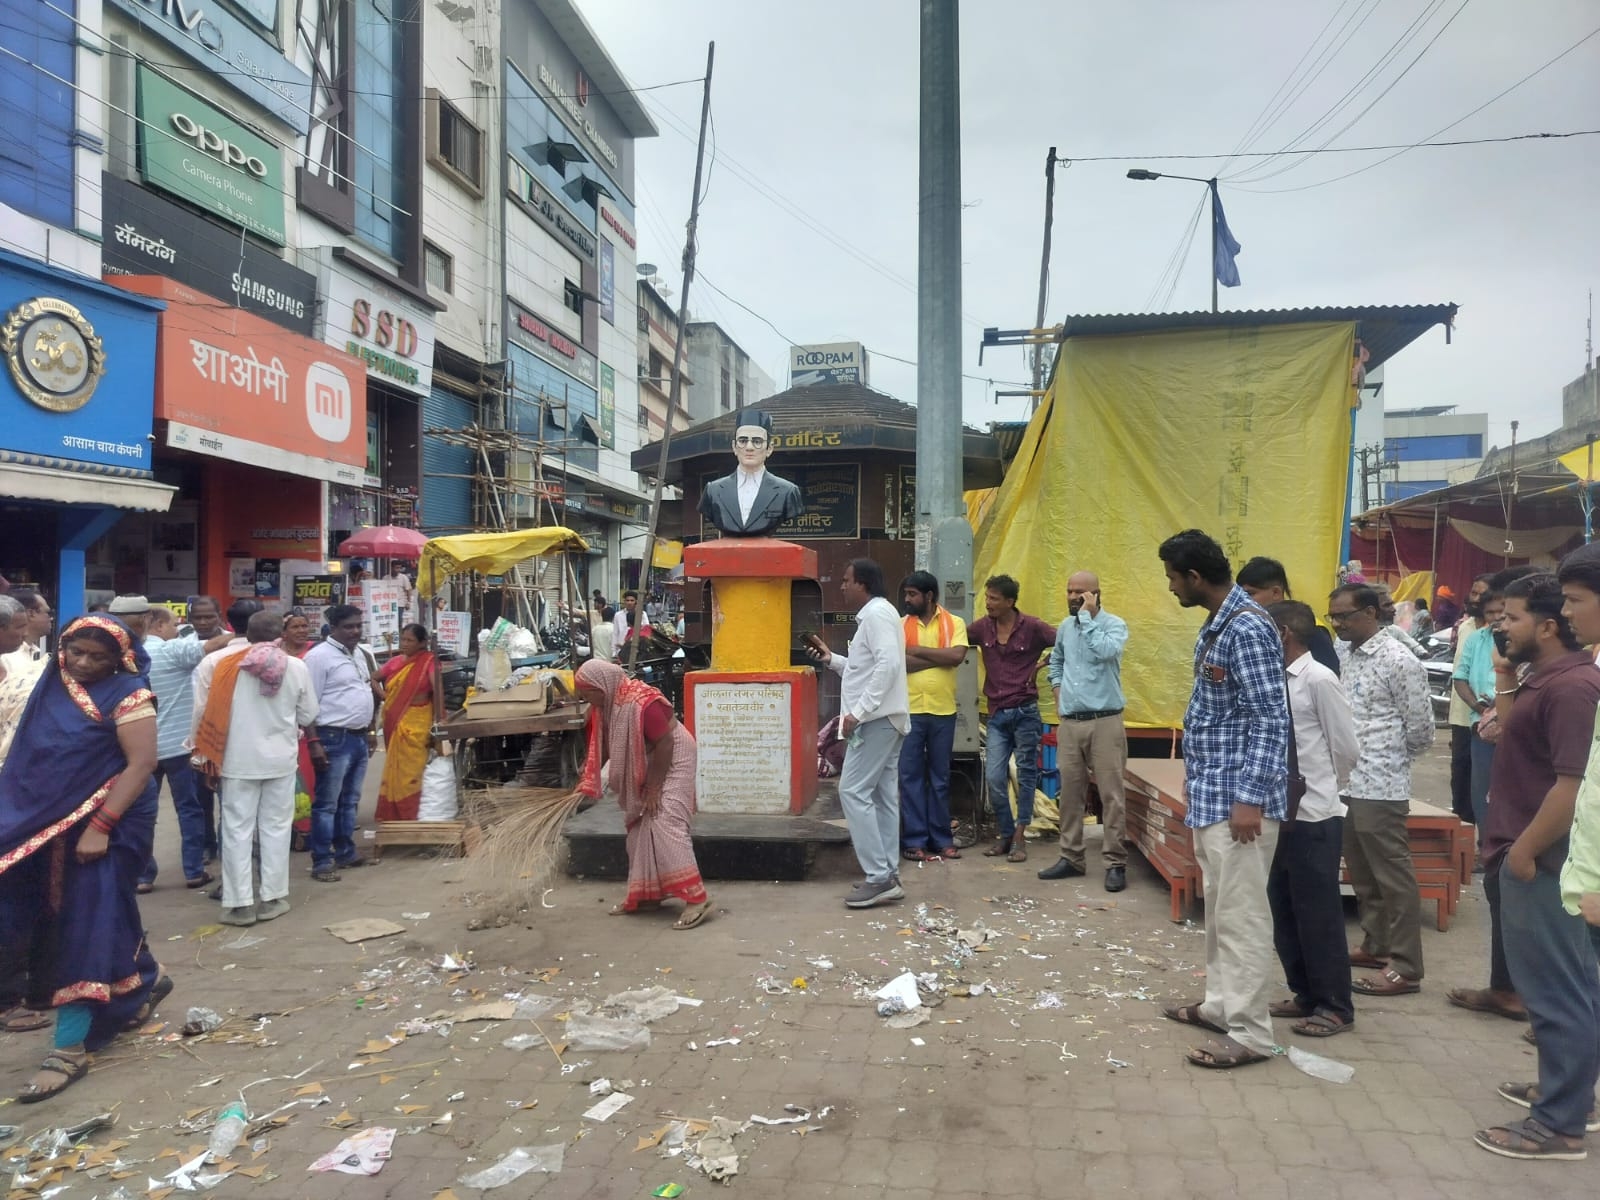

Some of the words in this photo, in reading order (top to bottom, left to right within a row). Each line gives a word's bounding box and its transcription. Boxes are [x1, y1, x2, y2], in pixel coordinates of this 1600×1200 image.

[182, 158, 222, 189] Camera
[223, 179, 253, 205] Phone
[231, 272, 305, 319] SAMSUNG
[351, 298, 418, 358] SSD
[189, 338, 289, 404] शाओमी
[797, 352, 854, 366] ROOPAM
[62, 435, 95, 450] आसाम
[97, 440, 115, 454] चाय
[116, 442, 143, 459] कंपनी
[785, 430, 842, 447] मंदिर
[797, 513, 833, 527] मंदिर
[295, 579, 332, 598] जयंत
